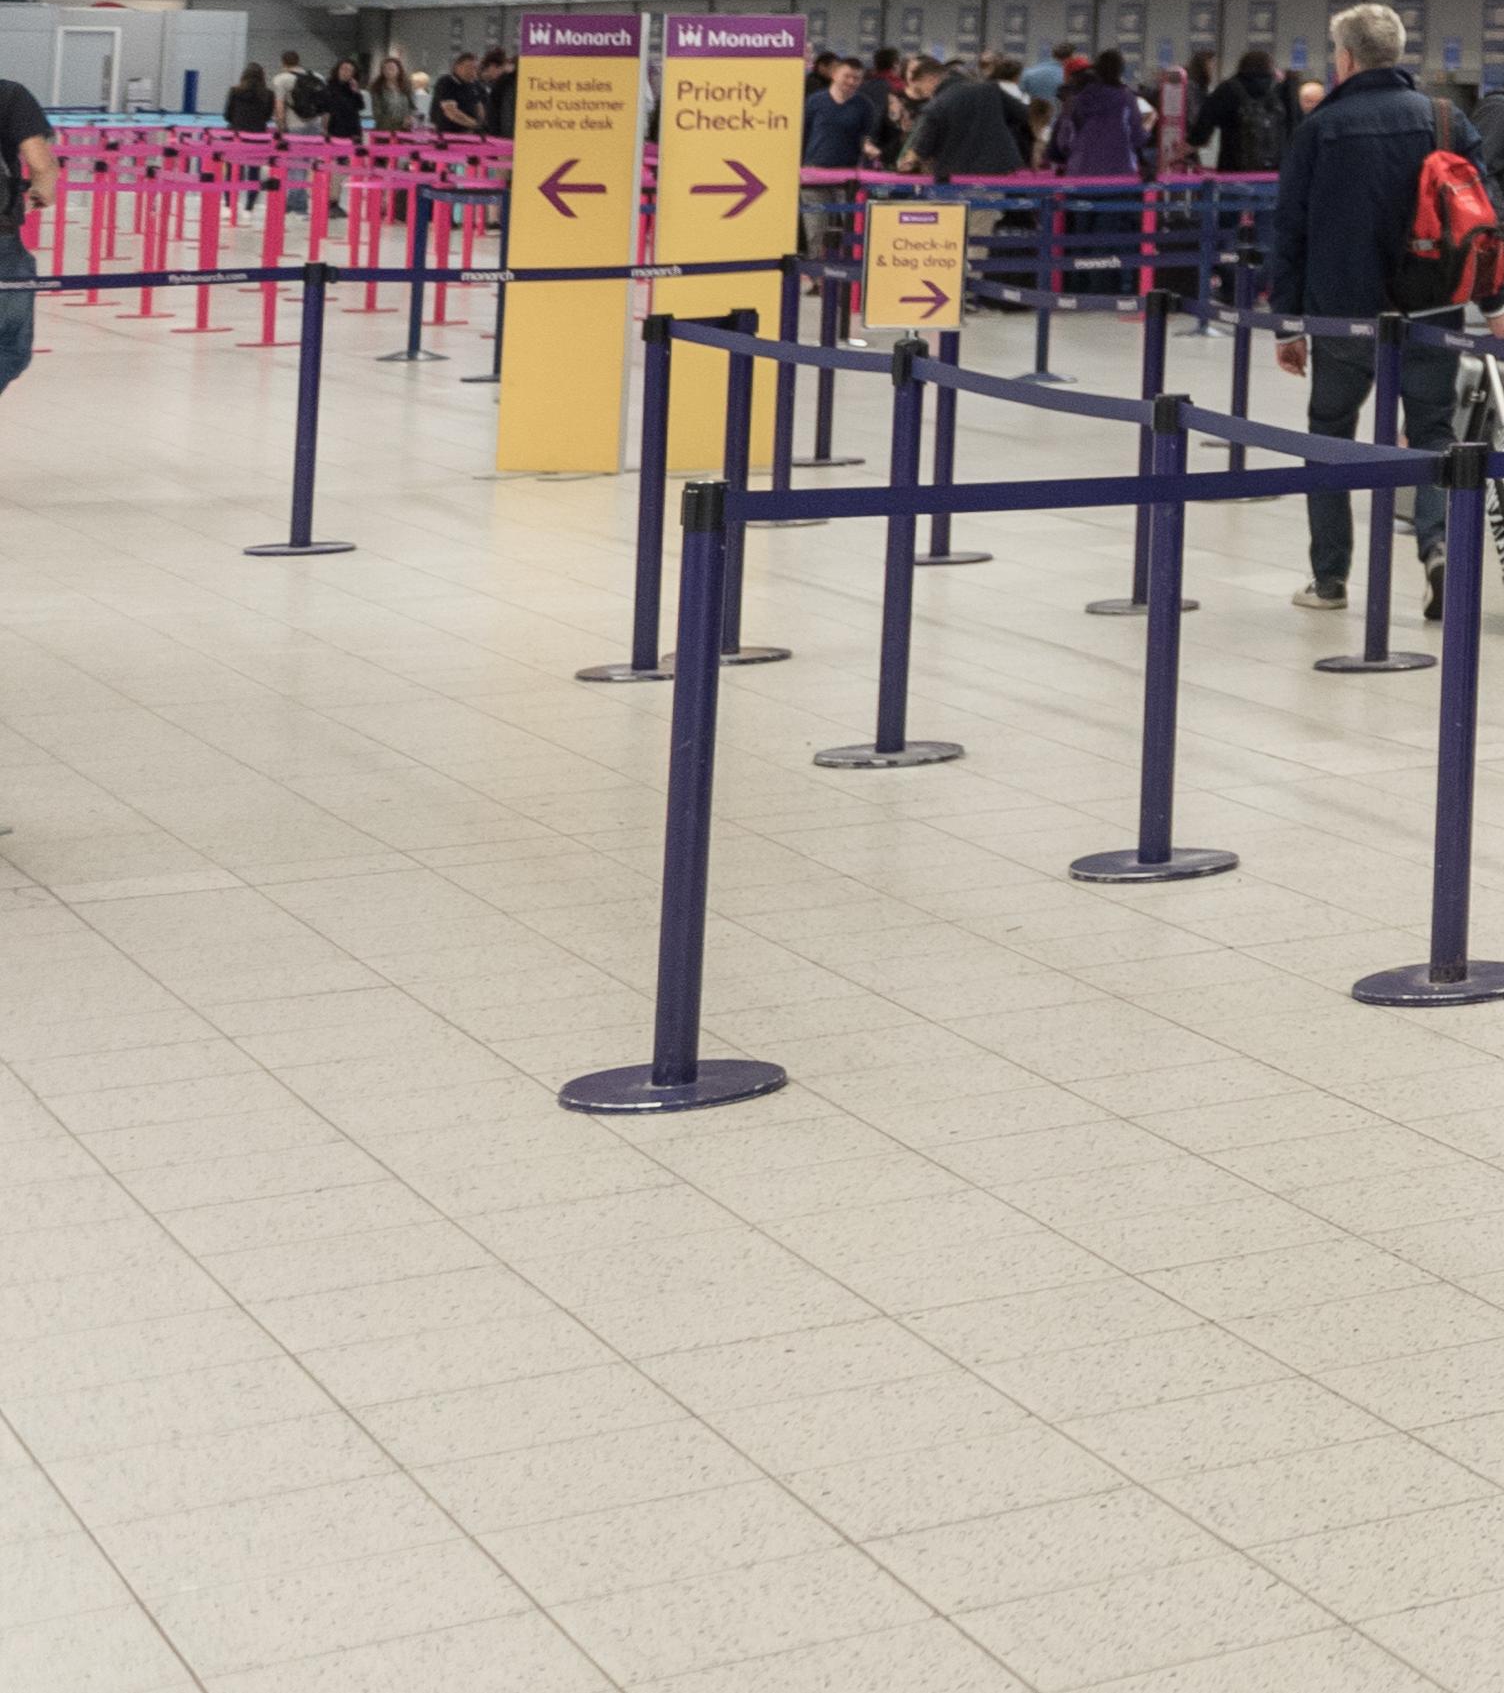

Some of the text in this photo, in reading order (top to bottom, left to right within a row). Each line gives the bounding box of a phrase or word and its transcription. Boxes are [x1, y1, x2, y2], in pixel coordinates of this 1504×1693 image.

[555, 29, 631, 46] Monarch
[708, 30, 794, 48] Monarch
[528, 77, 612, 93] Ticket sales
[677, 80, 766, 104] Priority
[526, 97, 624, 111] and customer
[525, 115, 613, 131] service desk
[676, 109, 789, 131] Check-in
[892, 238, 957, 251] Check-in
[876, 255, 957, 269] & bag drop
